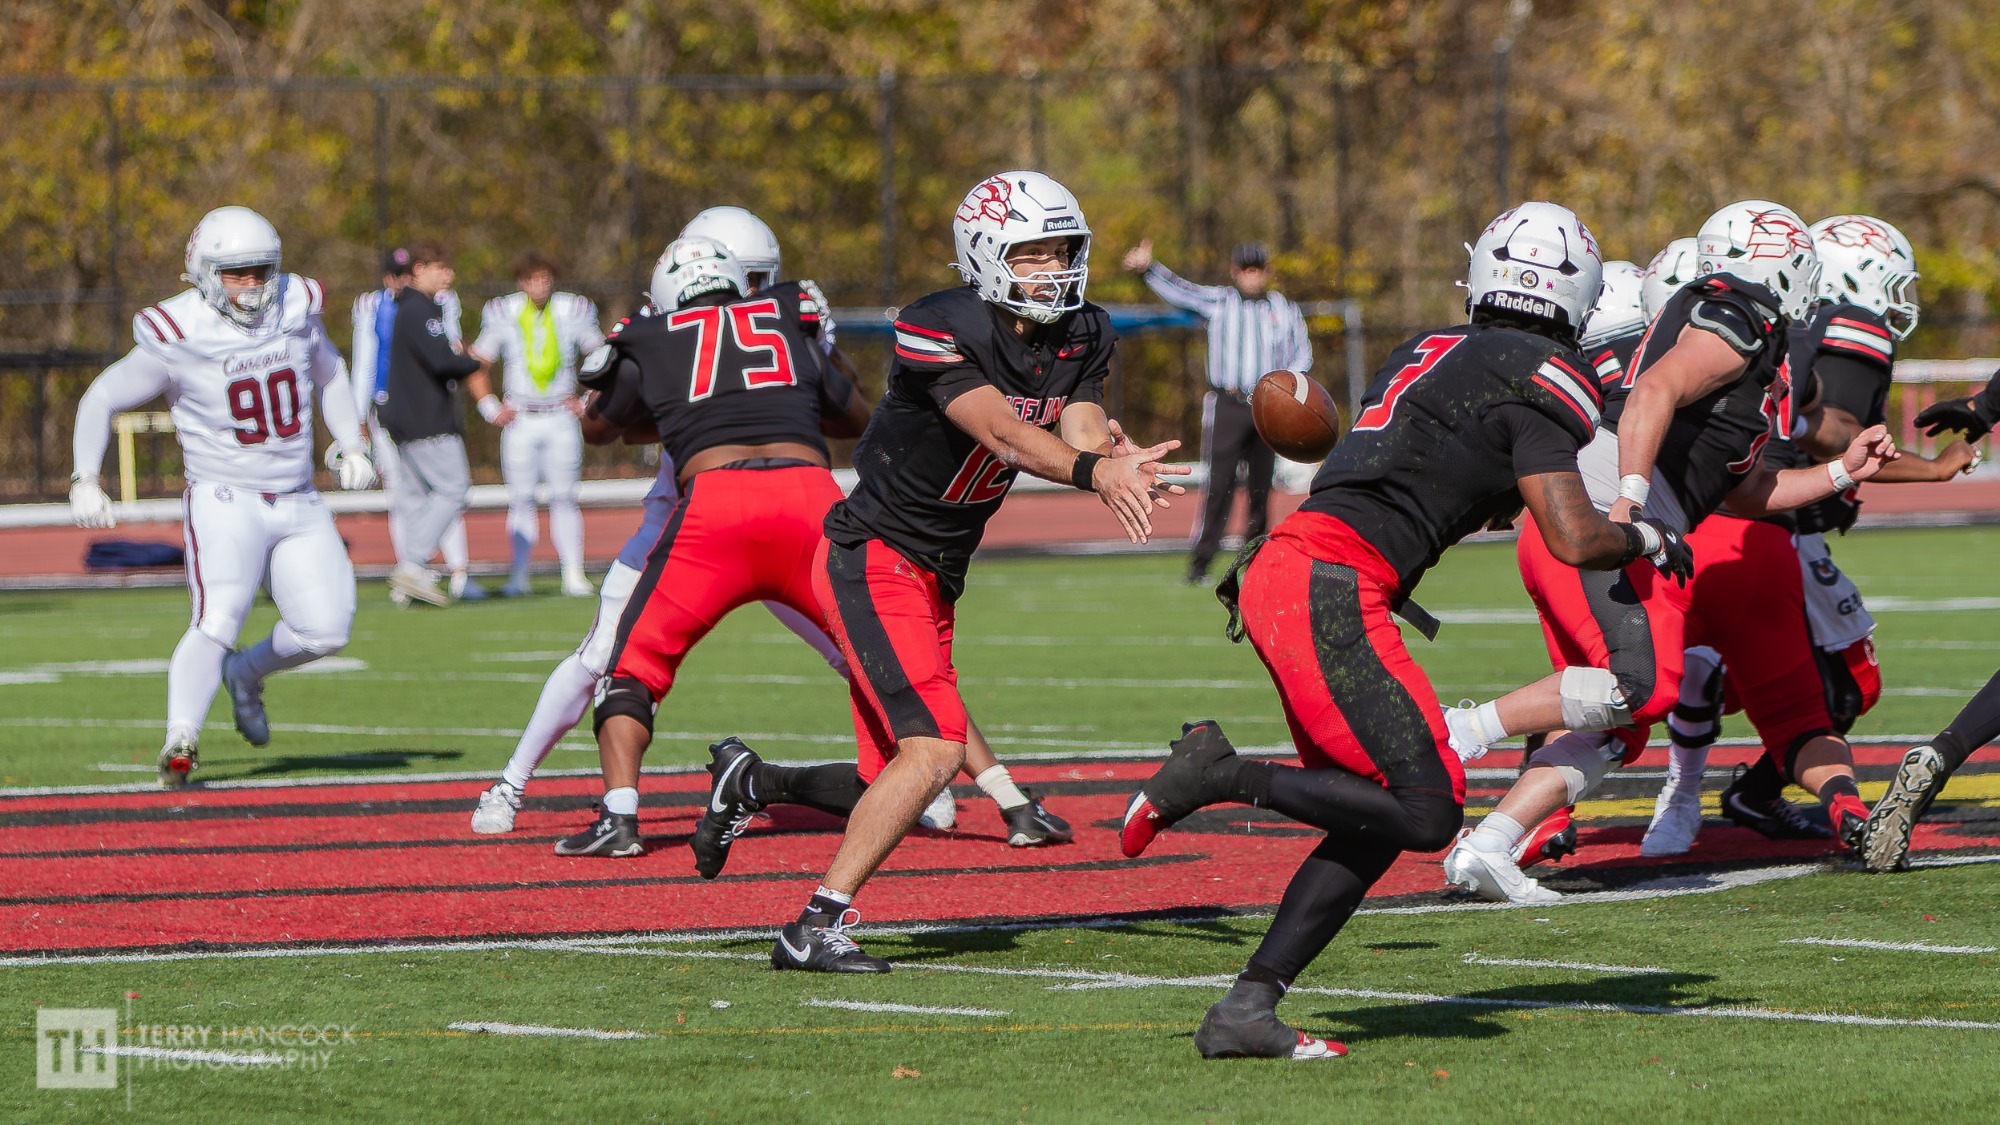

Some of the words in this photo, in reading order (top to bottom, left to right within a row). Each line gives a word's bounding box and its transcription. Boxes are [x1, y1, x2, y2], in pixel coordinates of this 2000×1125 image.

[1047, 219, 1078, 230] Riddell
[1530, 248, 1538, 257] 3
[1494, 292, 1556, 319] Riddell
[667, 298, 797, 403] 75
[227, 367, 301, 445] 90
[1351, 334, 1468, 432] 3
[939, 443, 1010, 504] 12
